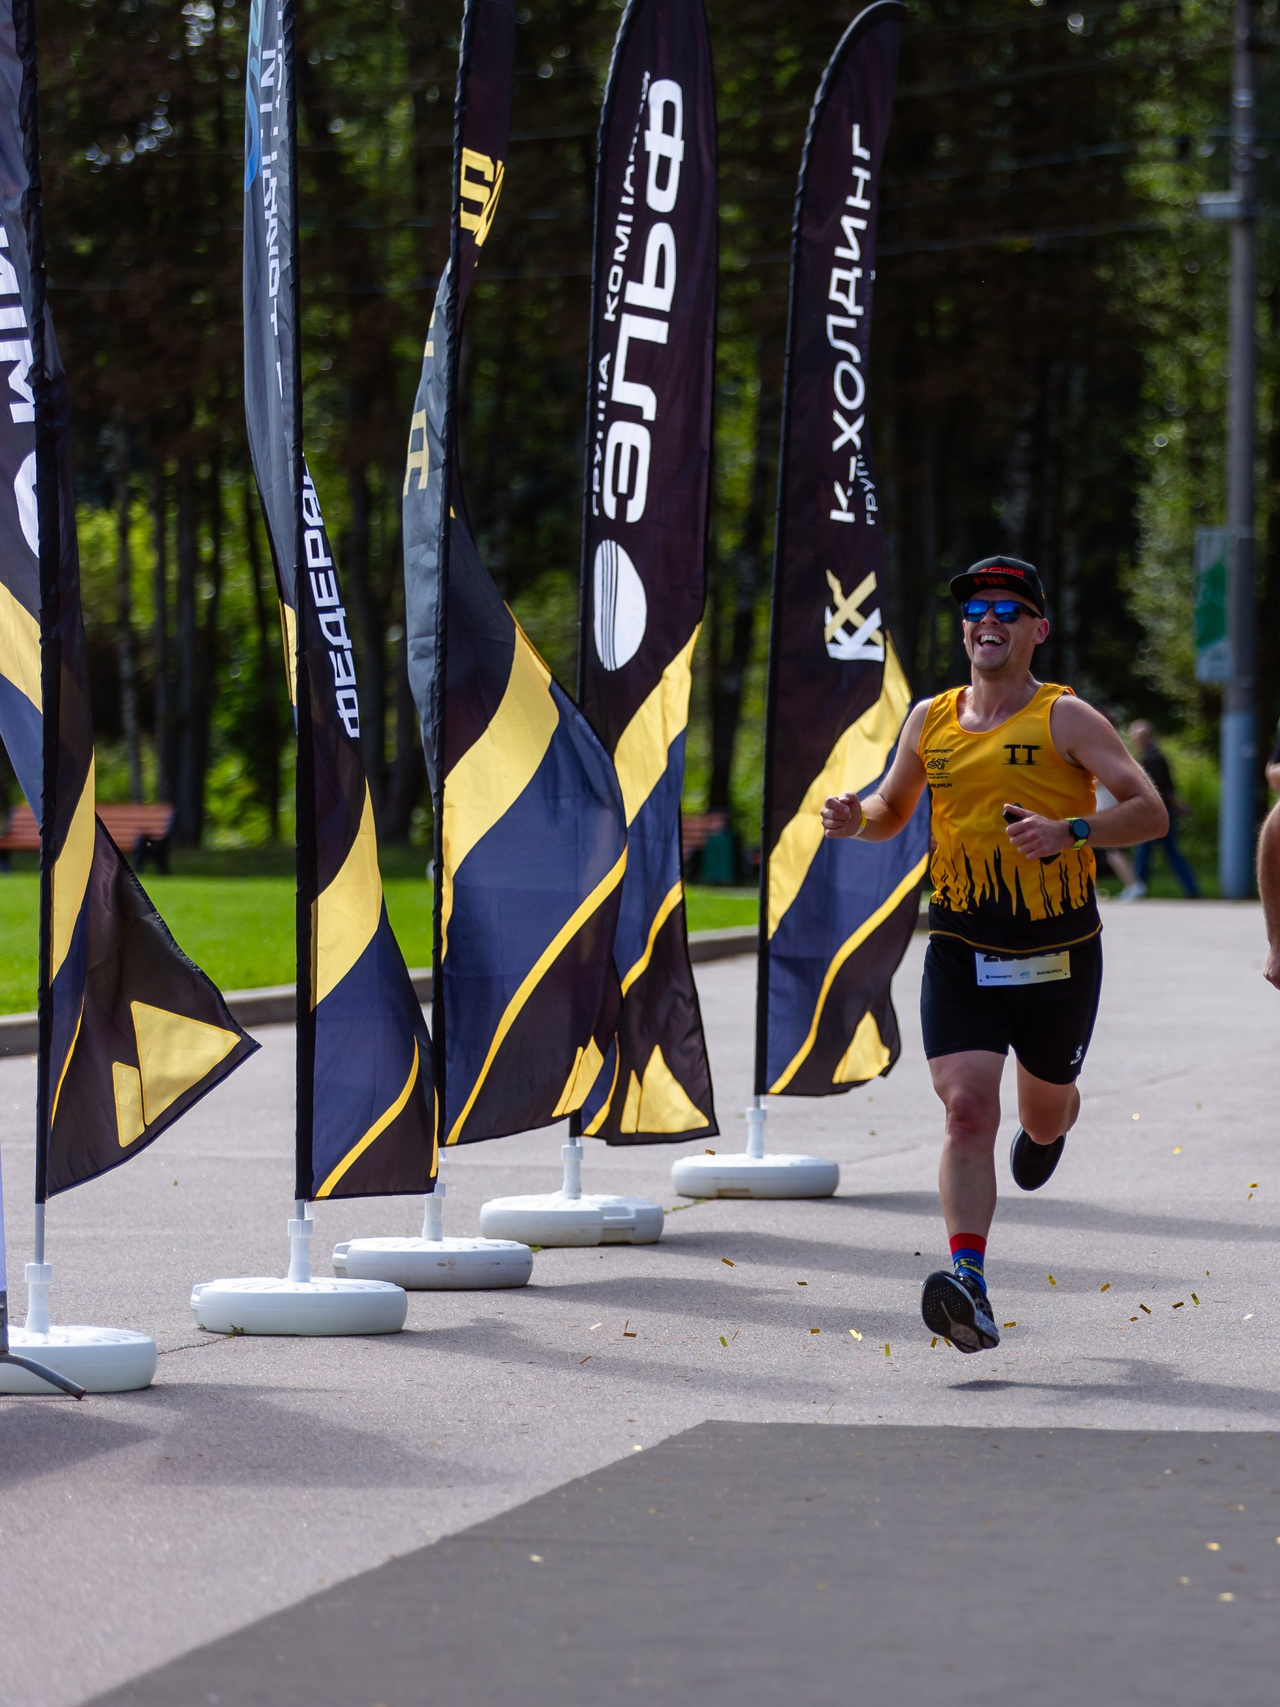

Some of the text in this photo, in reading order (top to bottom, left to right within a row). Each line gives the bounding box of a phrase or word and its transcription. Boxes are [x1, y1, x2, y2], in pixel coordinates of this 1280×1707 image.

[603, 79, 685, 523] ЭЛЬФ
[827, 123, 871, 523] К-ХОЛДИНГ
[302, 452, 360, 739] ФЕДЕРА
